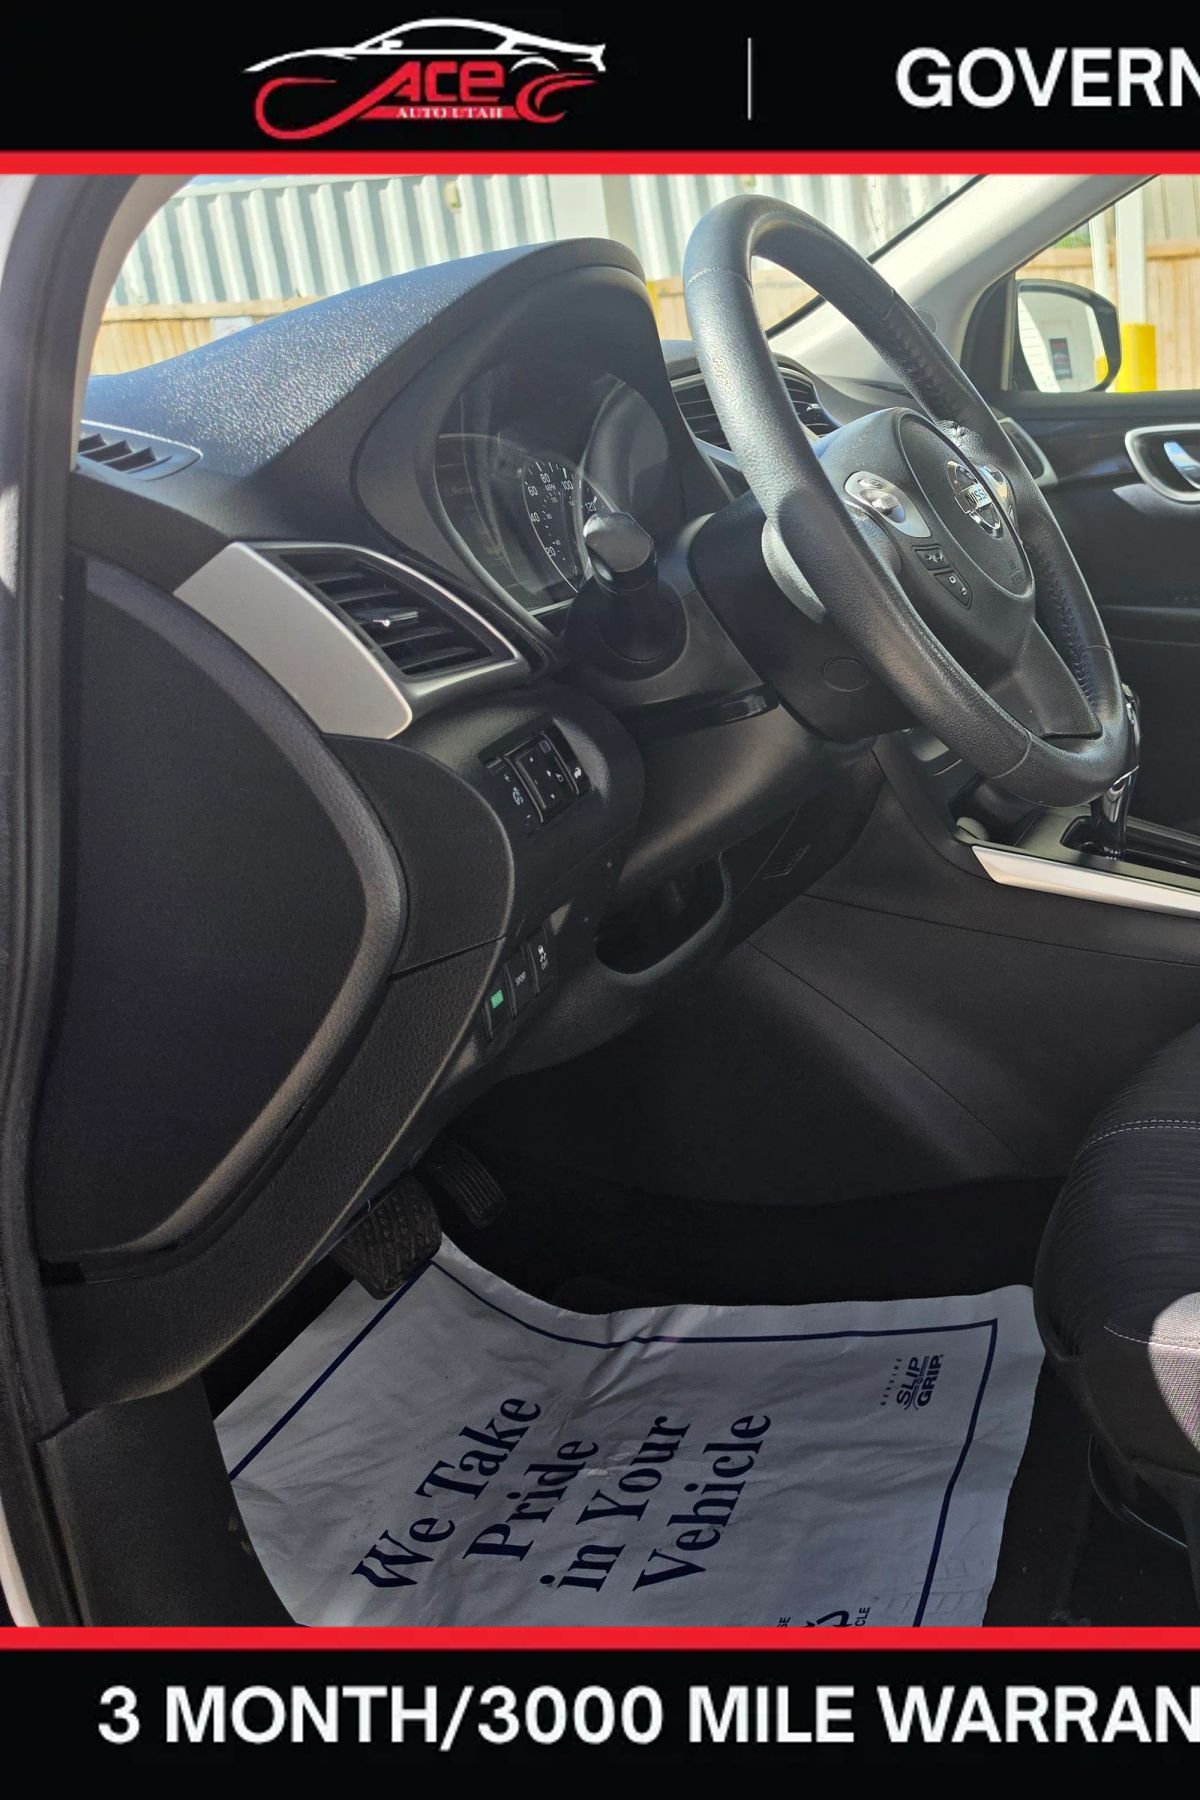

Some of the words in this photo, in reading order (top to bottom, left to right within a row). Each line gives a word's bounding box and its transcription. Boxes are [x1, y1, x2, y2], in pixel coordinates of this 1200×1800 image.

[527, 485, 539, 497] 60
[540, 472, 551, 484] 80
[561, 480, 574, 491] 100
[529, 512, 540, 523] 40
[896, 1356, 920, 1406] SLIP
[917, 1354, 944, 1407] GRIP
[351, 1517, 456, 1589] We
[414, 1398, 542, 1500] Take
[576, 1415, 692, 1522] Your
[462, 1440, 599, 1562] Pride
[632, 1414, 772, 1592] Vehicle
[539, 1543, 626, 1593] in
